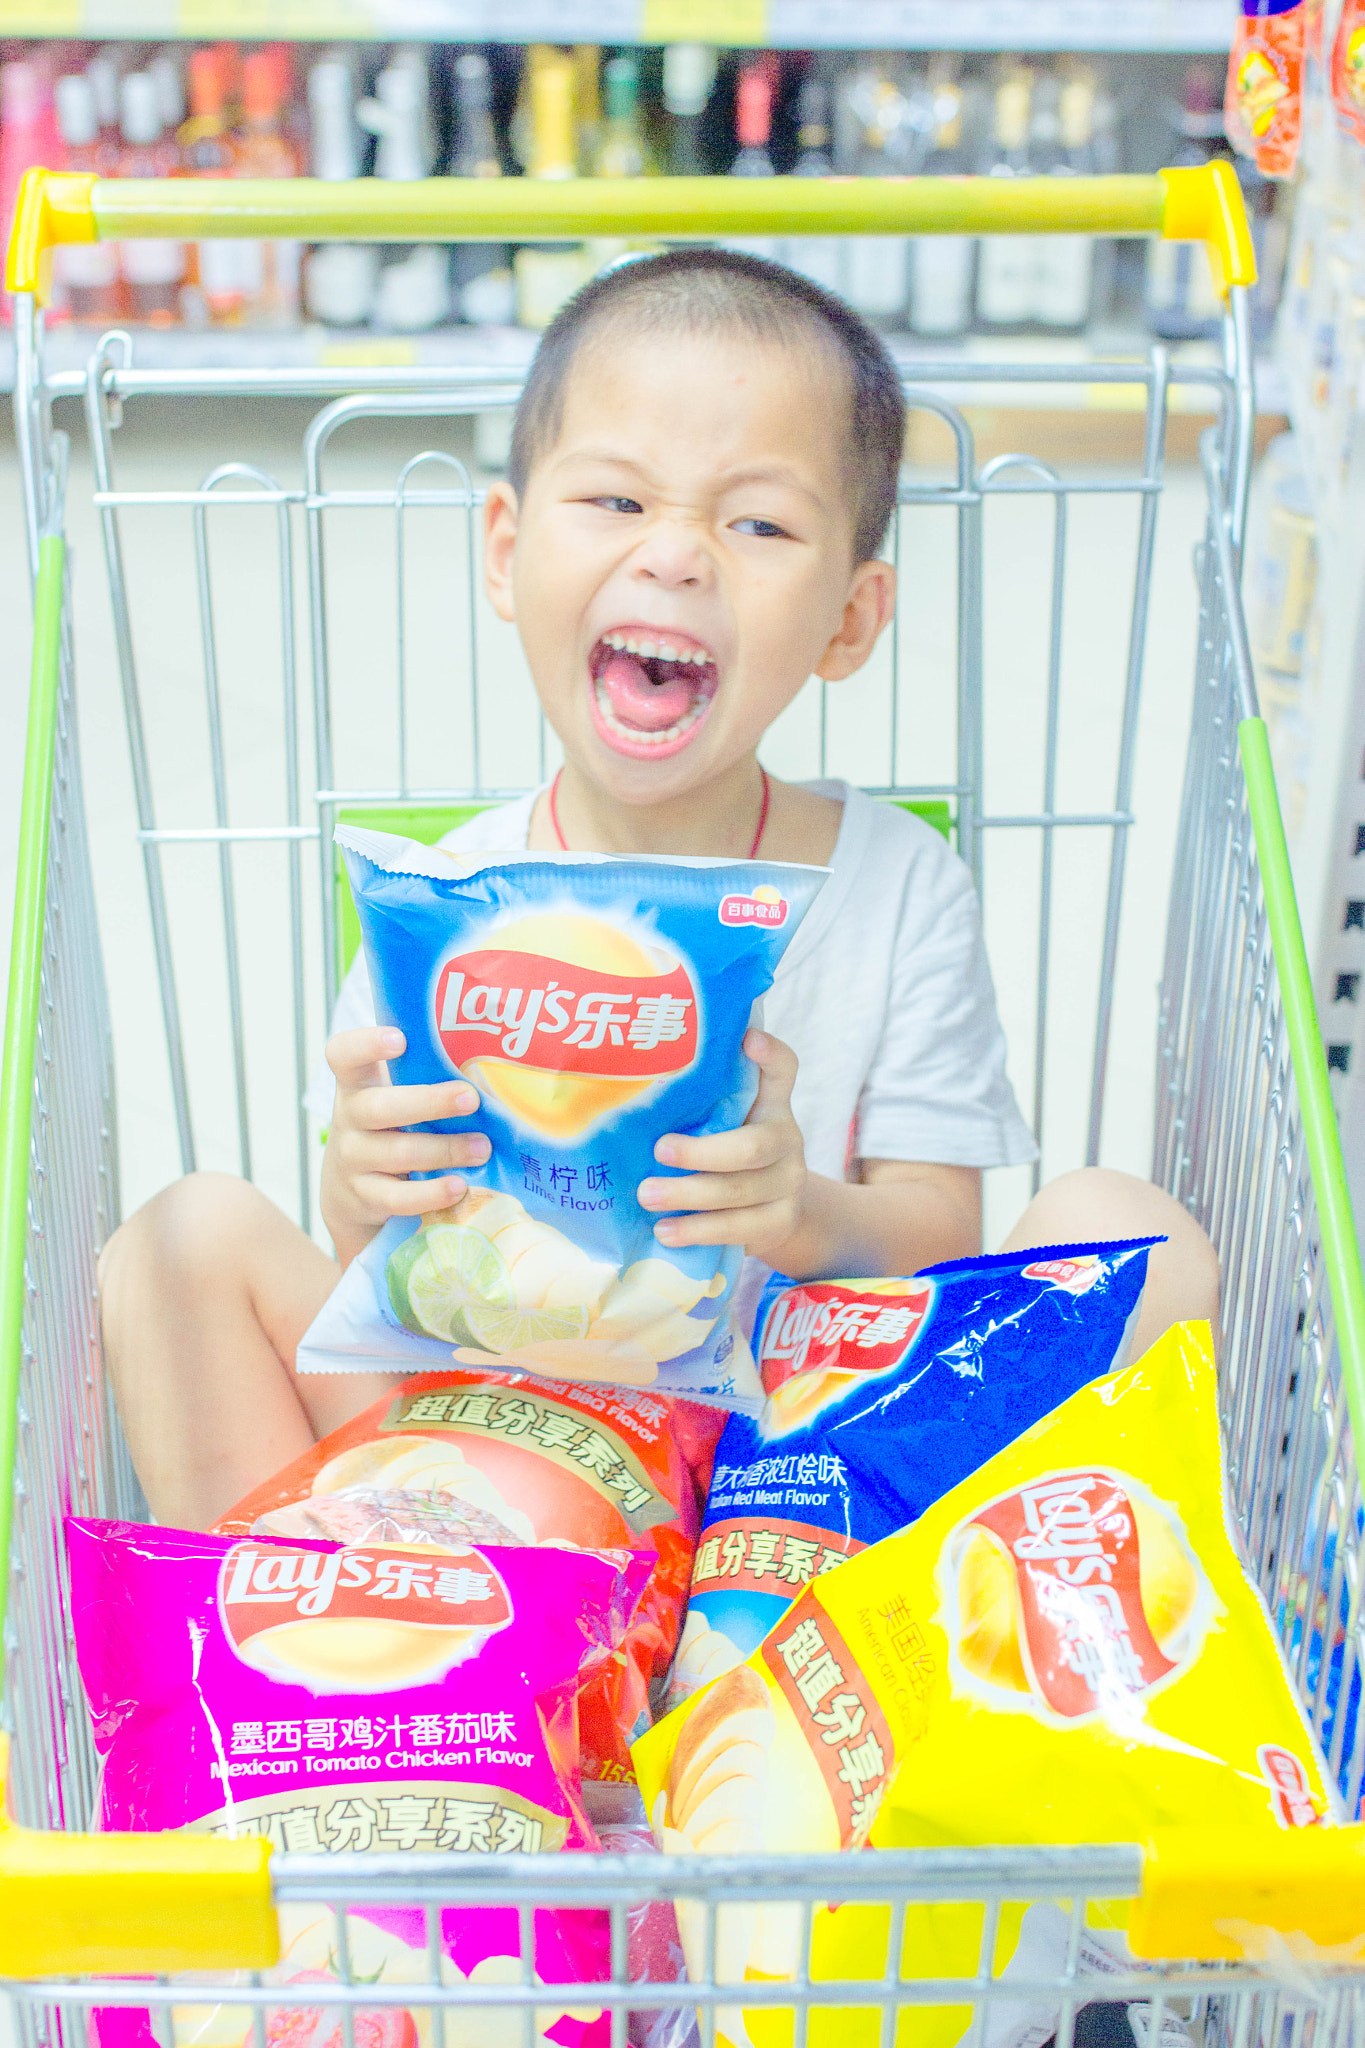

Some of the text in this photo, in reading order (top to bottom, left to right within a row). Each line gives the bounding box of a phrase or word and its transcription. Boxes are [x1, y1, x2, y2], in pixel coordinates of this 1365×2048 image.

[524, 1175, 616, 1212] Lime Flavor
[568, 1388, 607, 1411] BBQ
[606, 1404, 659, 1443] Flavor
[398, 1394, 654, 1513] 超值分享系列
[732, 1490, 753, 1506] Red
[753, 1489, 783, 1505] Meat
[784, 1489, 831, 1506] Flavor
[857, 1608, 897, 1688] American
[230, 1711, 518, 1755] 墨西哥鸡汁番茄味
[210, 1747, 535, 1779] Mexican Tomato Chicken Flavor
